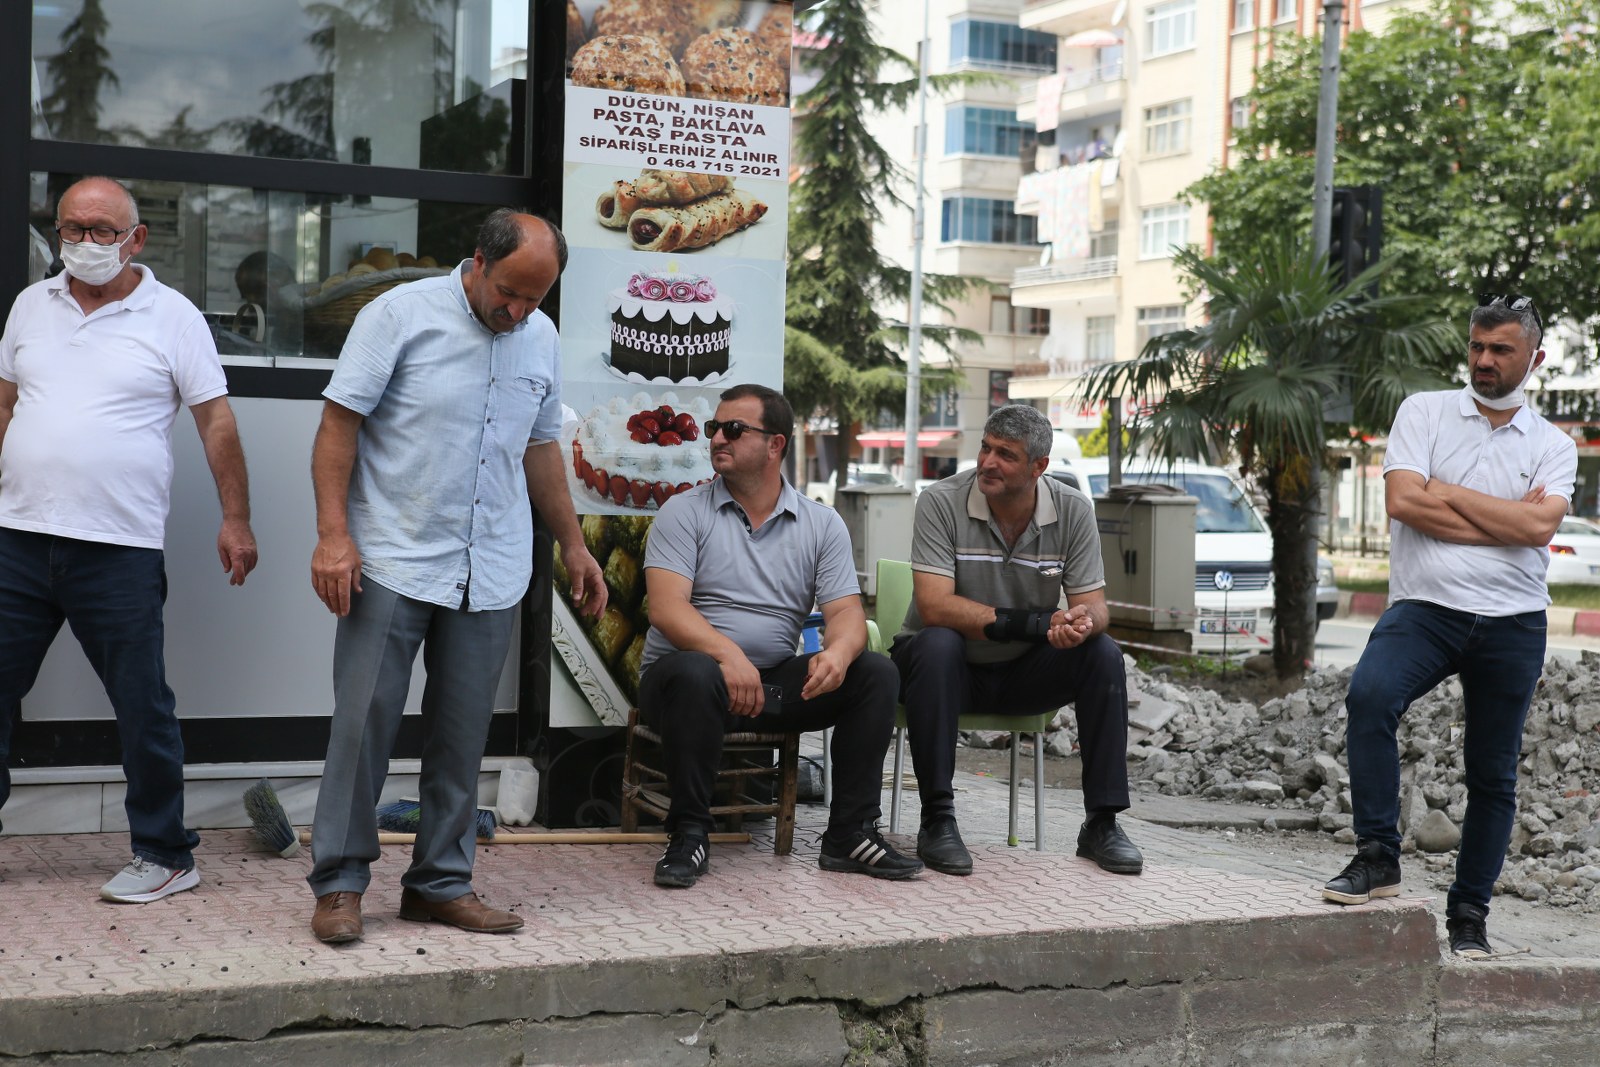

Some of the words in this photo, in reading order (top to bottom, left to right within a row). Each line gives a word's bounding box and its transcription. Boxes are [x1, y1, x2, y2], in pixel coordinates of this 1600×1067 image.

[608, 96, 686, 116] DÜĞÜN,
[693, 104, 754, 120] NİŞAN
[593, 108, 664, 128] PASTA,
[672, 116, 766, 136] BAKLAVA
[613, 124, 662, 141] YAŞ
[670, 130, 748, 147] PASTA
[579, 135, 716, 158] SİPARİŞLERİNİZ
[721, 150, 778, 164] ALINIR
[647, 156, 657, 166] 0
[663, 158, 696, 169] 464
[702, 161, 734, 172] 715
[740, 165, 780, 177] 2021
